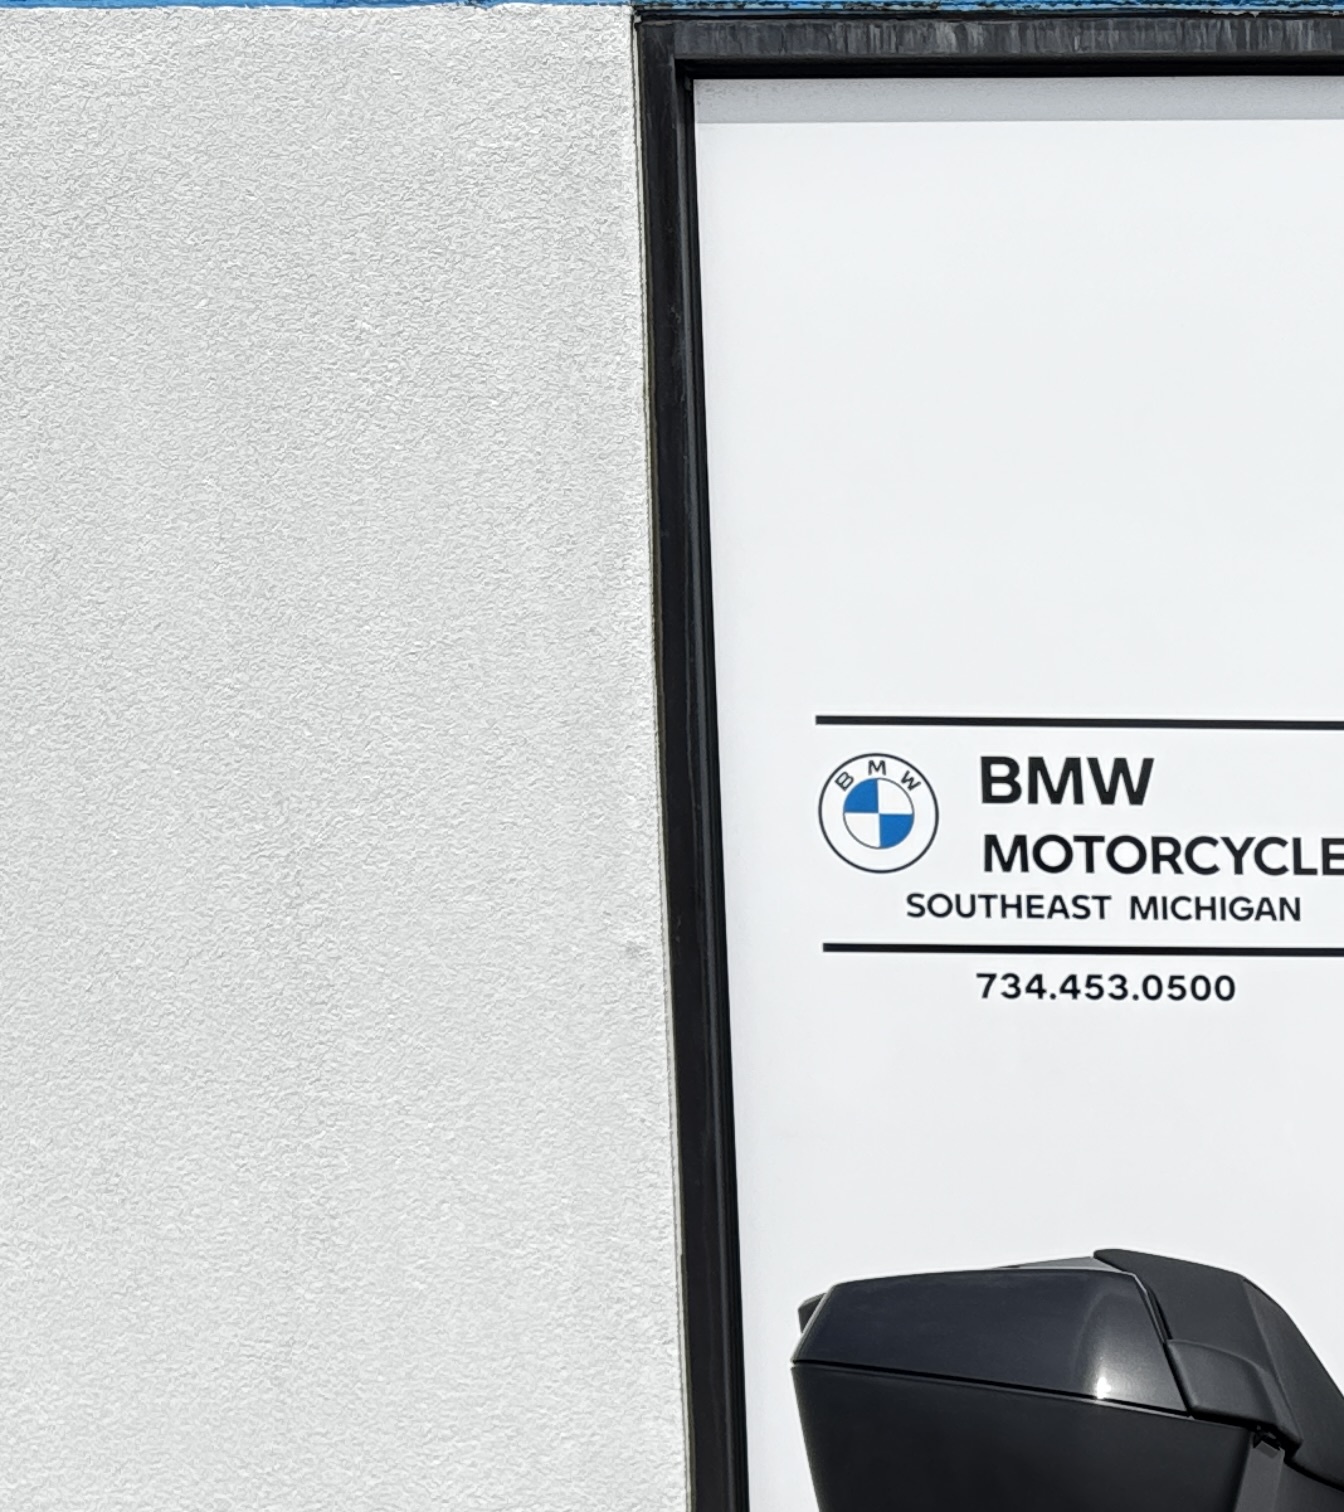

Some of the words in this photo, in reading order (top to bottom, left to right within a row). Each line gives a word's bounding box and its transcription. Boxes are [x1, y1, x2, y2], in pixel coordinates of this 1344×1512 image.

[833, 758, 921, 791] BMW
[981, 756, 1154, 805] BMW
[907, 893, 1111, 919] SOUTHEAST
[1131, 896, 1300, 921] MICHIGAN
[977, 973, 1235, 1001] 734.453.0500
